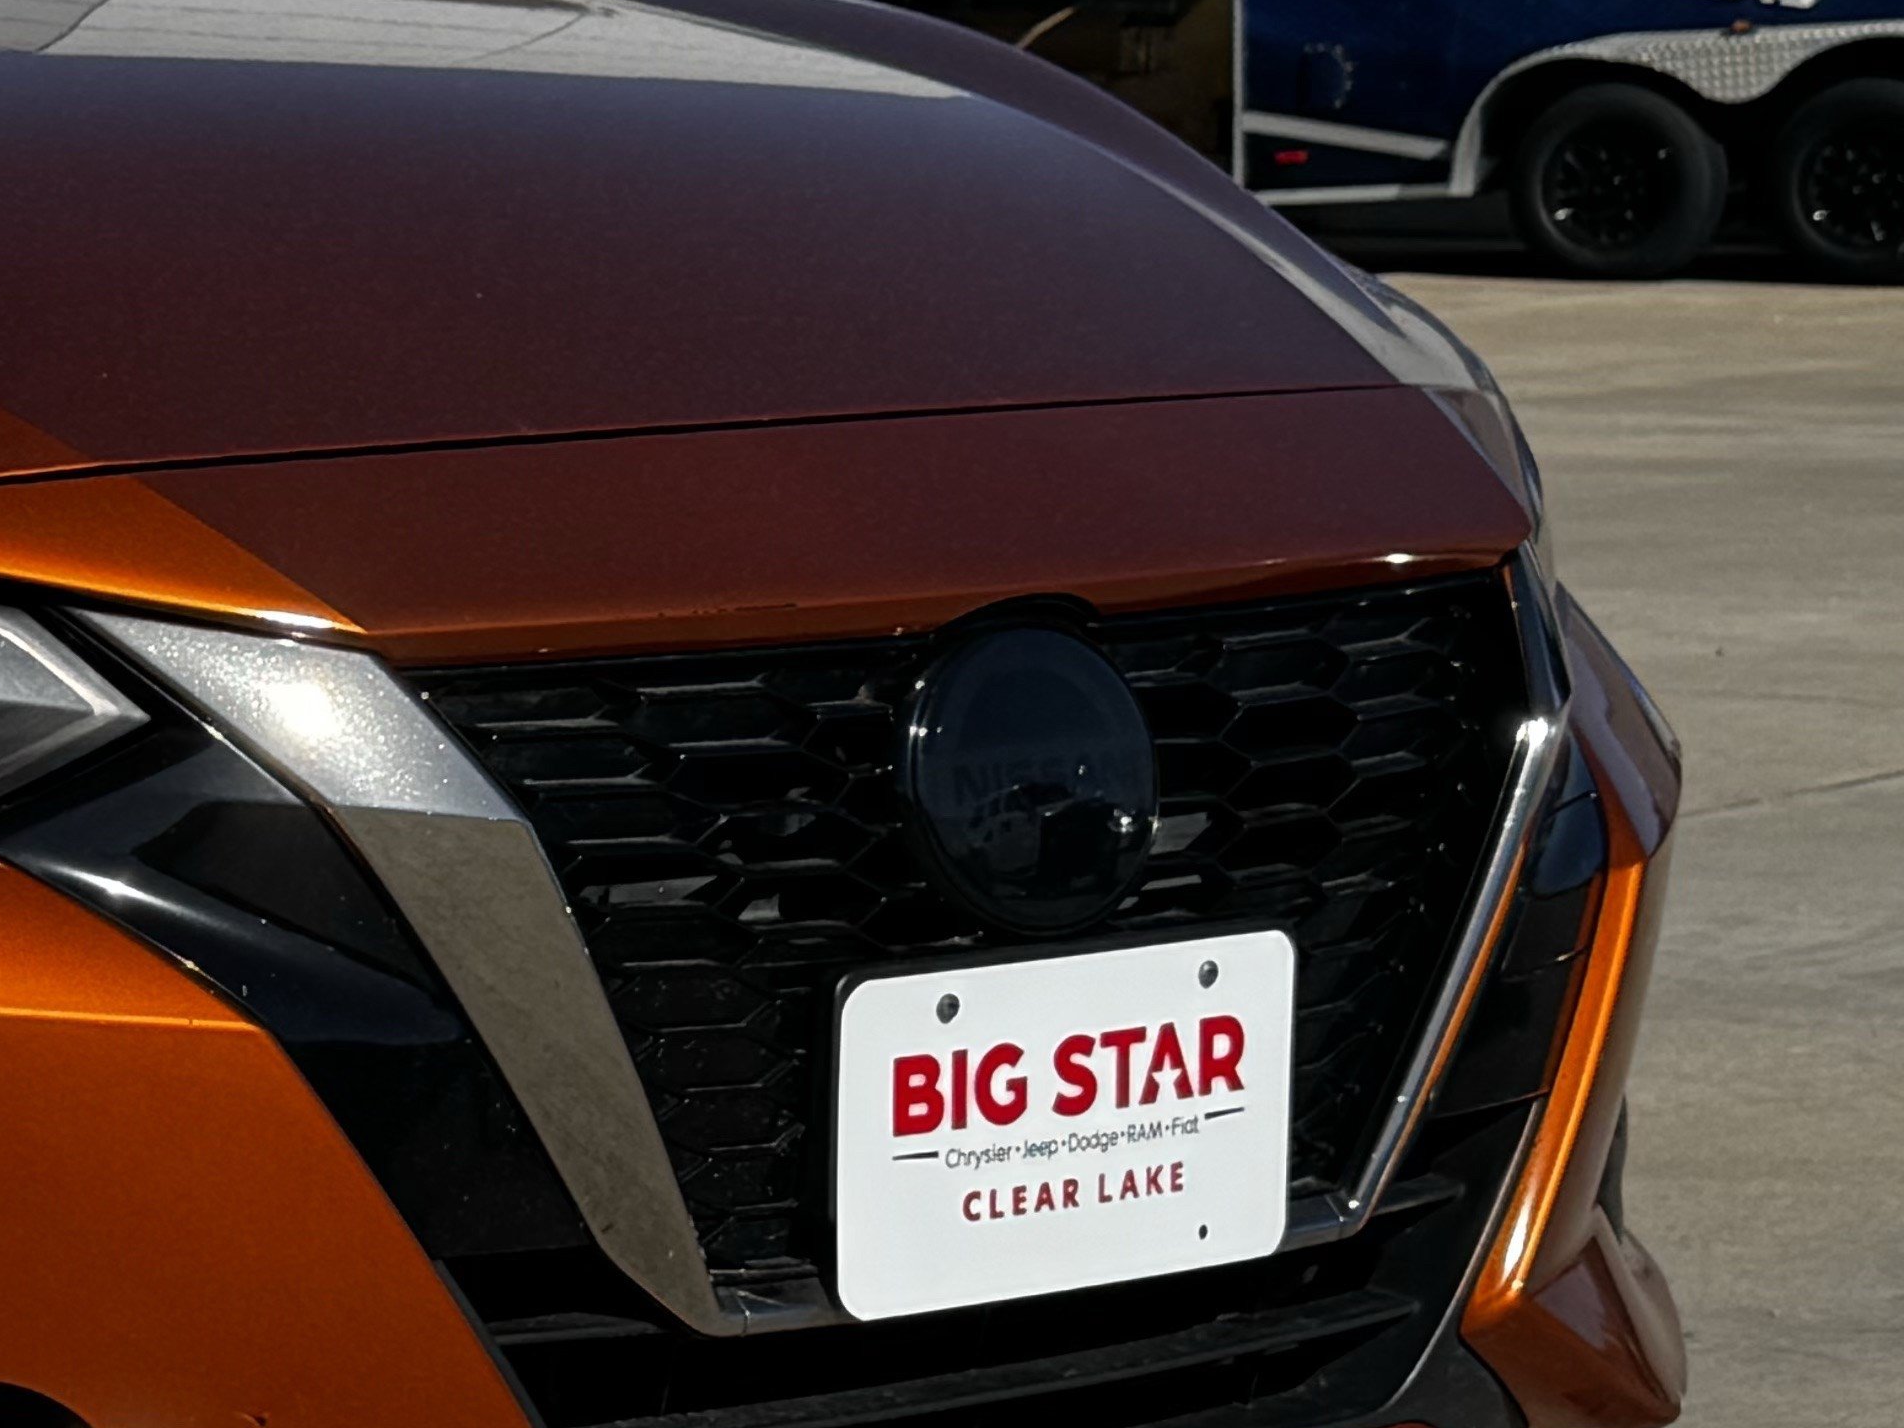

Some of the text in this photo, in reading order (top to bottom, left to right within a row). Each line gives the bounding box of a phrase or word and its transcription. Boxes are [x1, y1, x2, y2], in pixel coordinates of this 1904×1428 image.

[892, 1014, 1246, 1138] BIG STAR
[945, 1115, 1200, 1170] Chrysler Jeep Dodge RAM Fiat
[962, 1161, 1185, 1222] CLEAR LAKE
